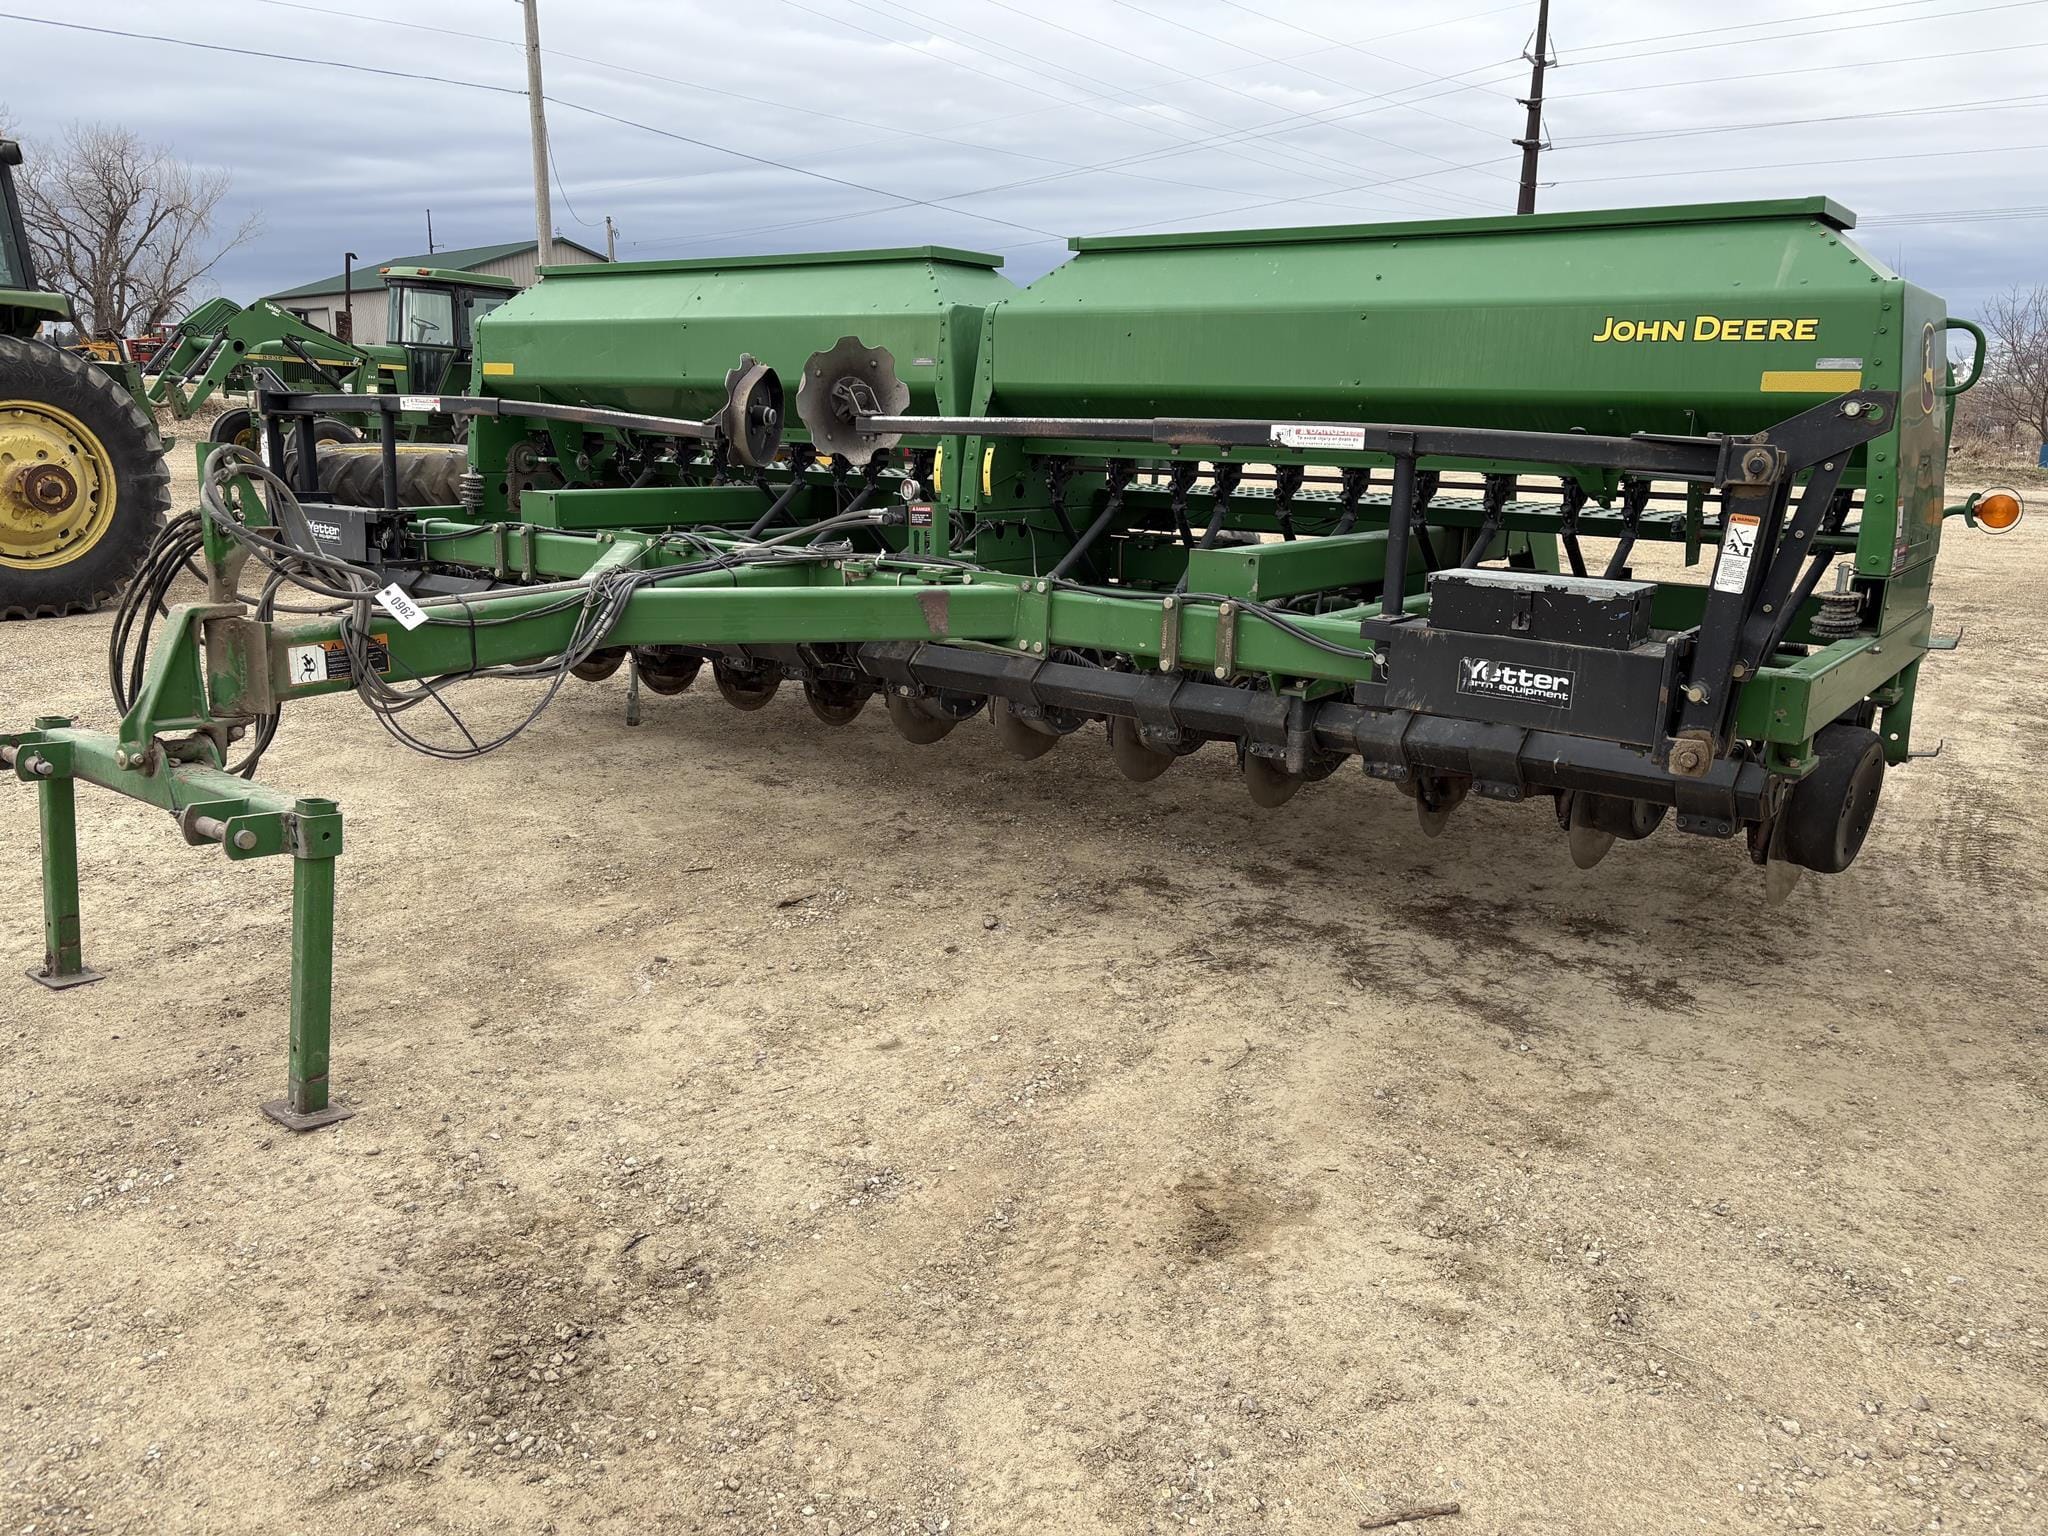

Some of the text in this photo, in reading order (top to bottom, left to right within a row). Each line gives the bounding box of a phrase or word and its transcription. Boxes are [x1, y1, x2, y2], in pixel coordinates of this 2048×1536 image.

[1592, 315, 1820, 342] JOHN DEERE
[308, 520, 340, 536] Yetter
[391, 597, 415, 619] 0962
[1463, 657, 1569, 691] Yetter
[1498, 684, 1569, 701] equipment
